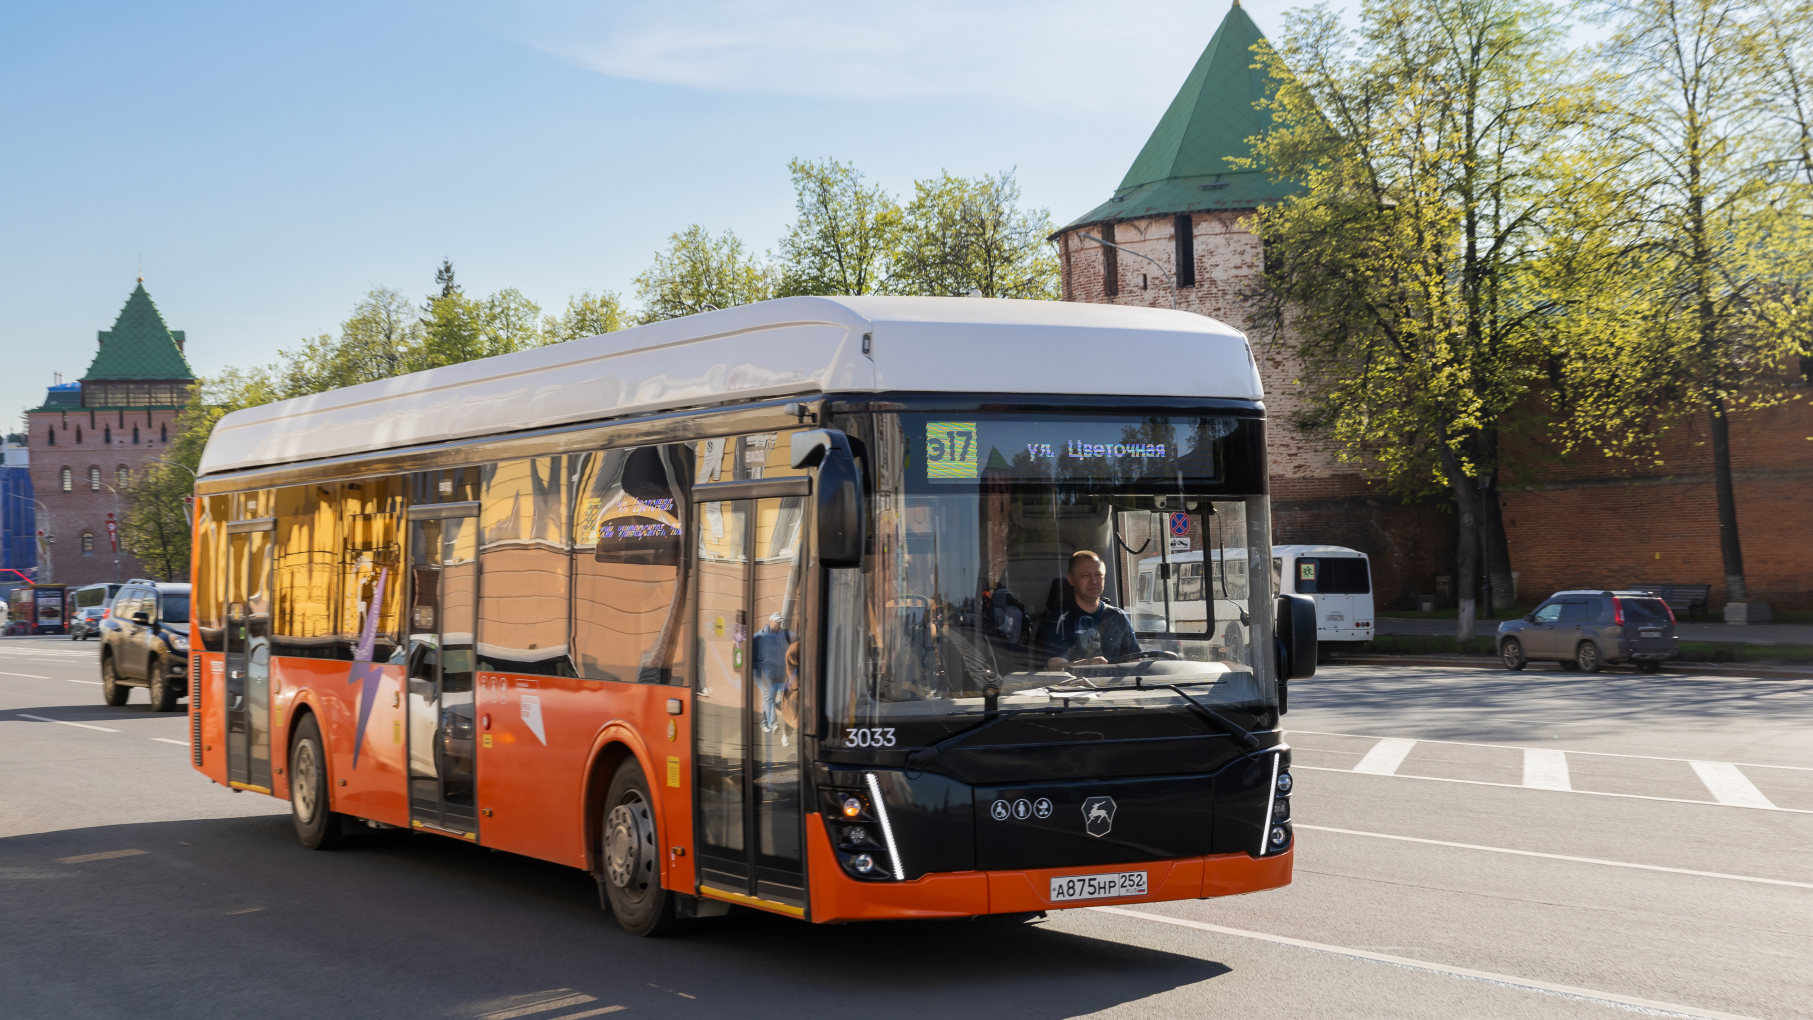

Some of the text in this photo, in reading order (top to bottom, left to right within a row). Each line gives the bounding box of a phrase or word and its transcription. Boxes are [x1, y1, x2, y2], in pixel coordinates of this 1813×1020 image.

[928, 431, 973, 461] э17
[1027, 440, 1165, 461] ул. Цветочная
[845, 727, 896, 747] 3033
[1120, 874, 1144, 888] 252
